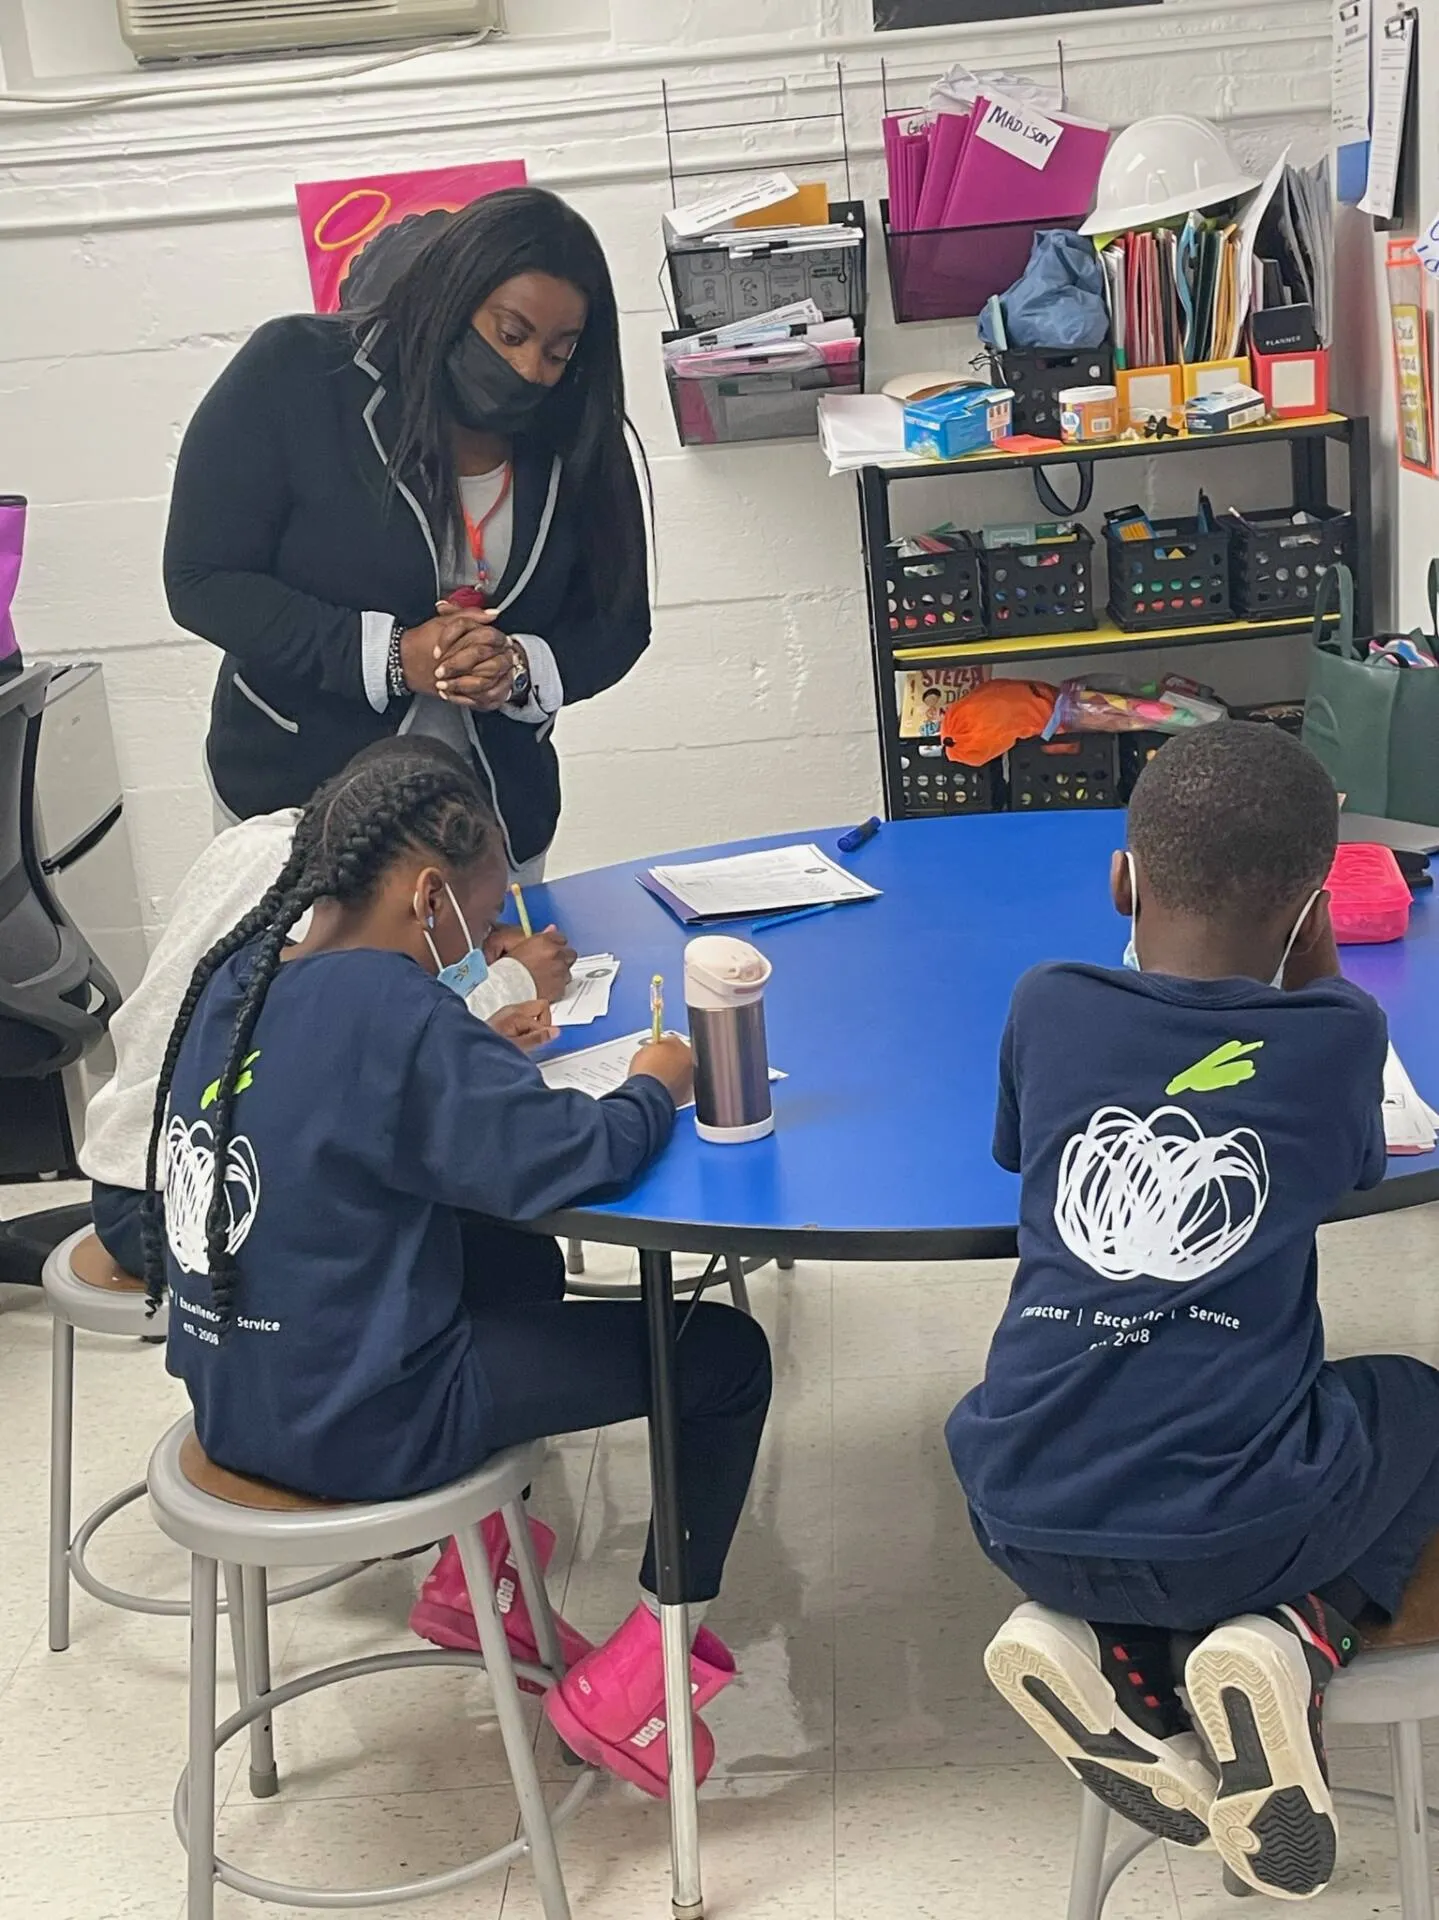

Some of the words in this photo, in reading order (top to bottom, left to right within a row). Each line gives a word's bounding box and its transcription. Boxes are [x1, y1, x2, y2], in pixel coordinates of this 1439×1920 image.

[987, 105, 1056, 147] MADISON
[1265, 335, 1301, 346] PLANNER
[237, 1316, 280, 1331] Service
[1021, 1306, 1071, 1320] aracter
[1189, 1305, 1240, 1329] Service
[198, 1327, 219, 1346] 2008
[629, 1717, 666, 1748] UGG
